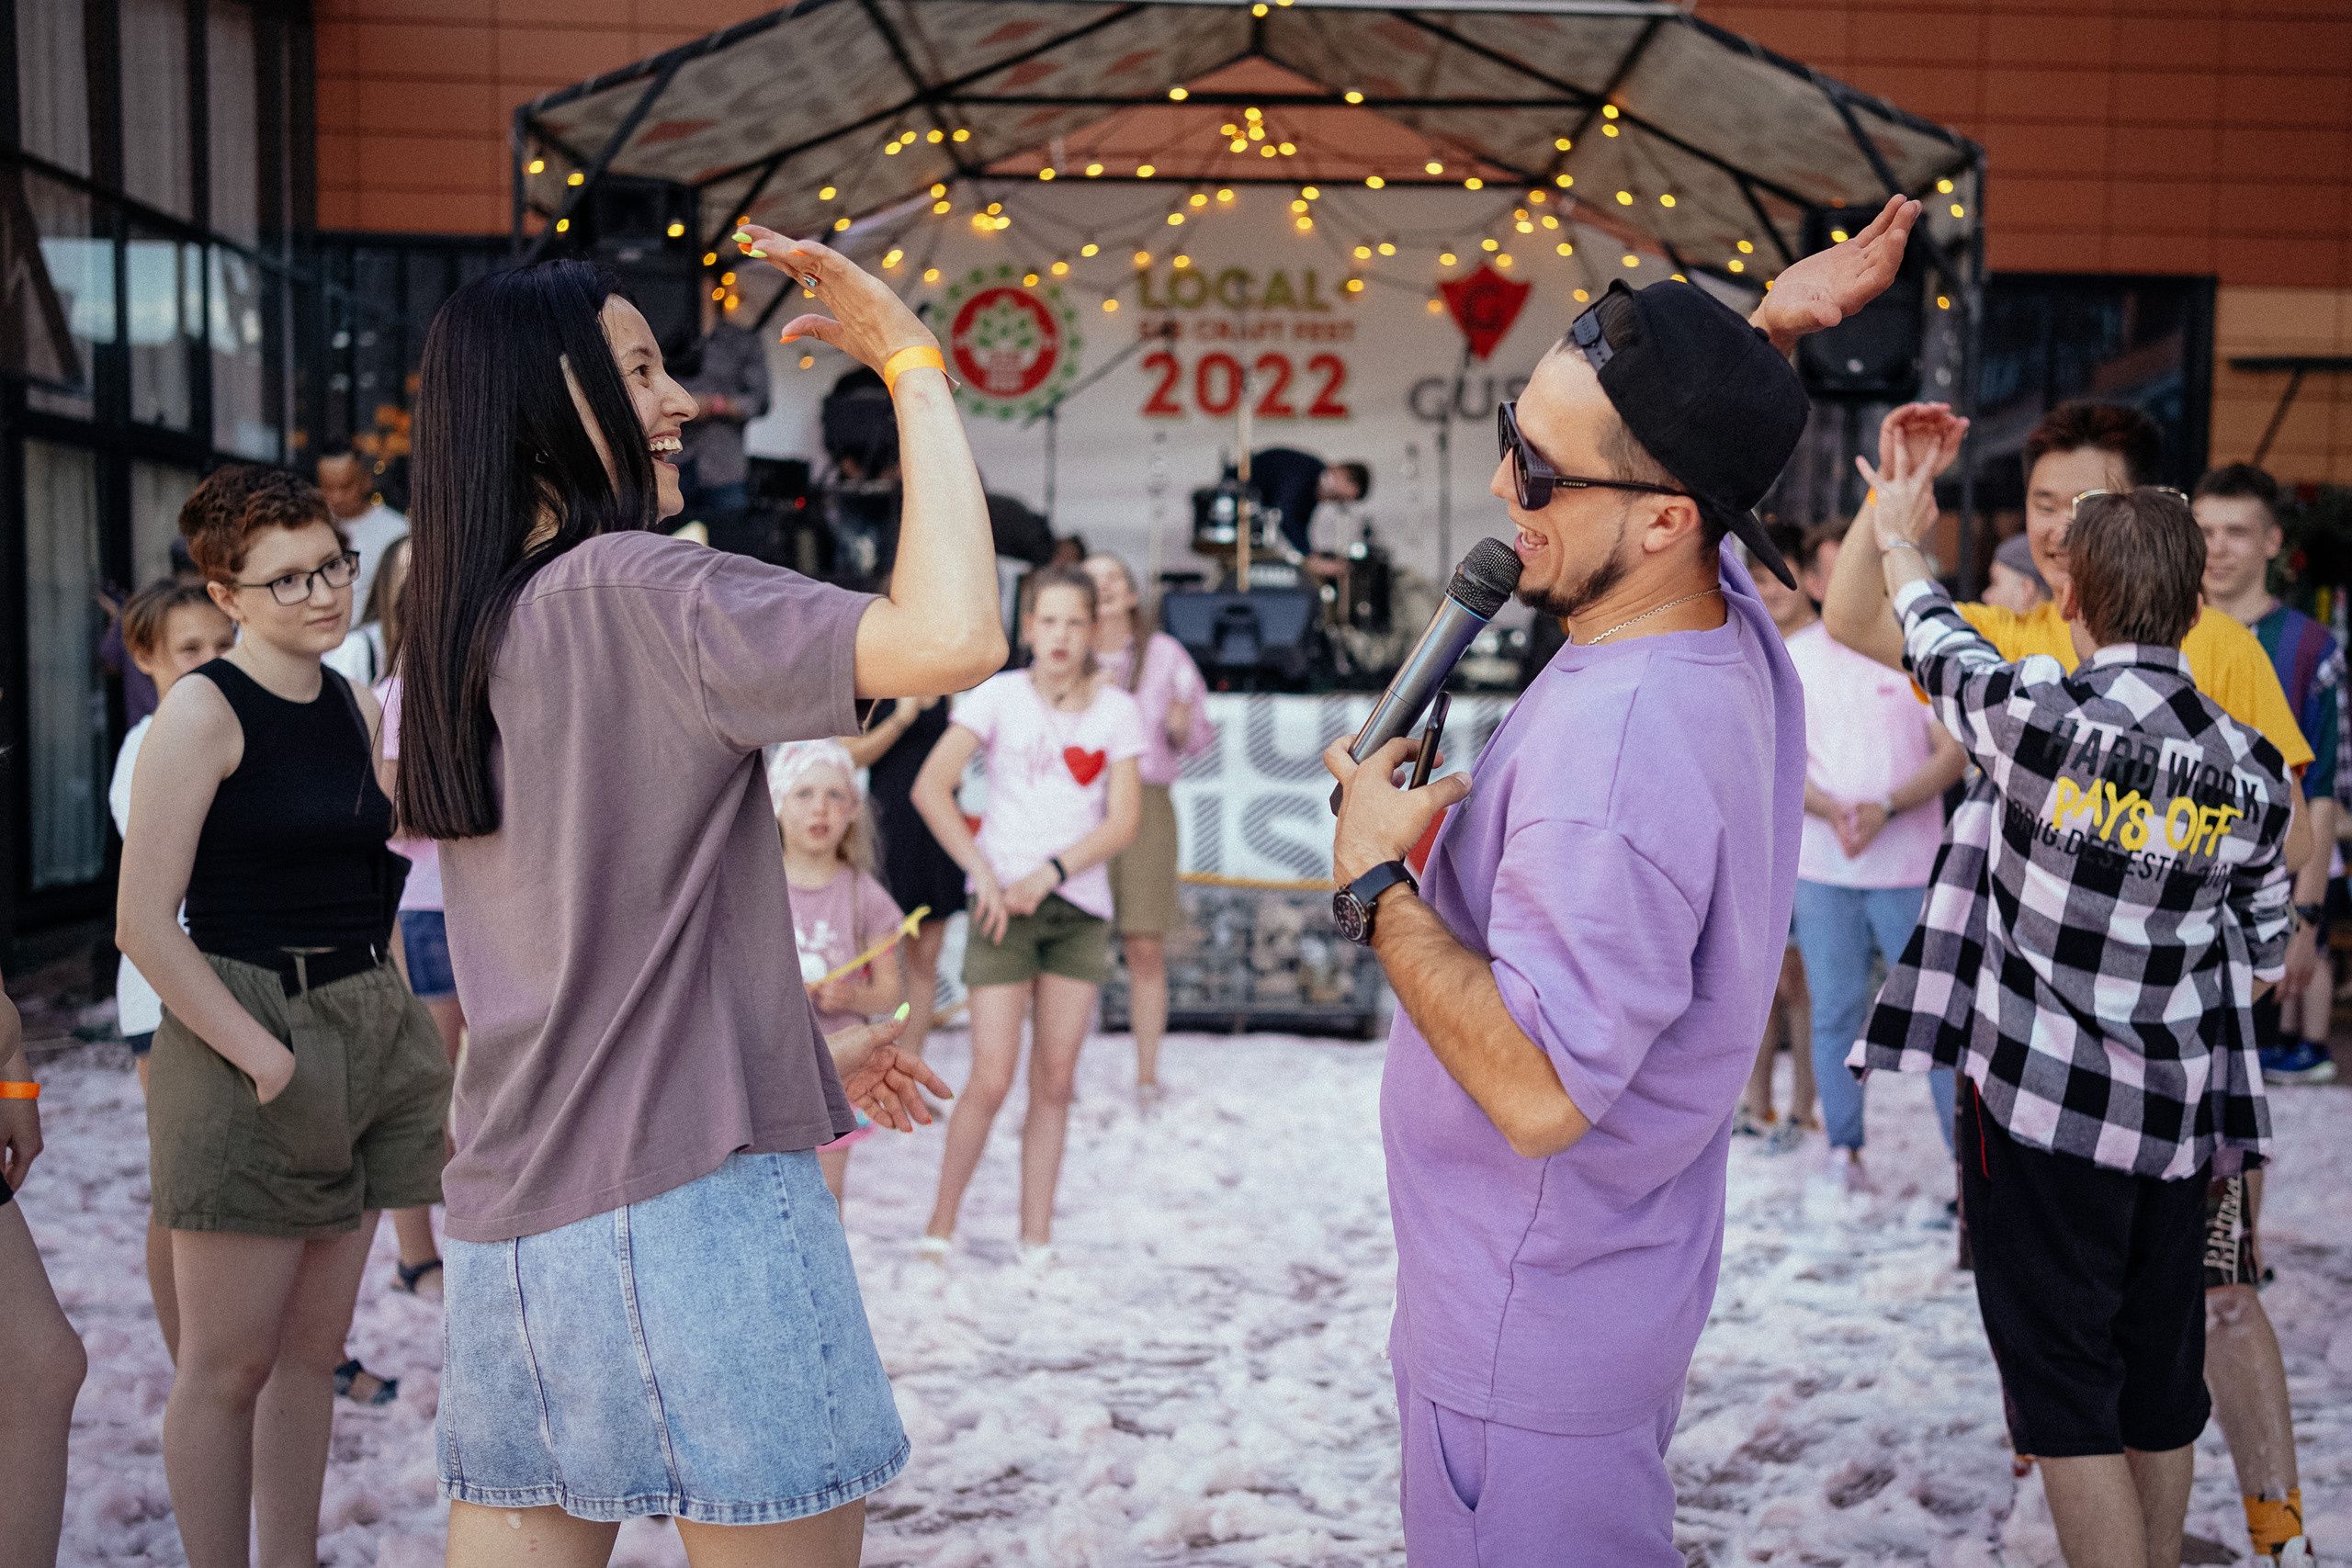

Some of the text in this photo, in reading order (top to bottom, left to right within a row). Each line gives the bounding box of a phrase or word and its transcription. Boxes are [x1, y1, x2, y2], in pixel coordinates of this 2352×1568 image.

[1136, 267, 1330, 311] LOCAL
[1141, 352, 1348, 418] 2022
[2042, 719, 2260, 825] HARD WORK
[2052, 776, 2244, 857] PAYS OFF
